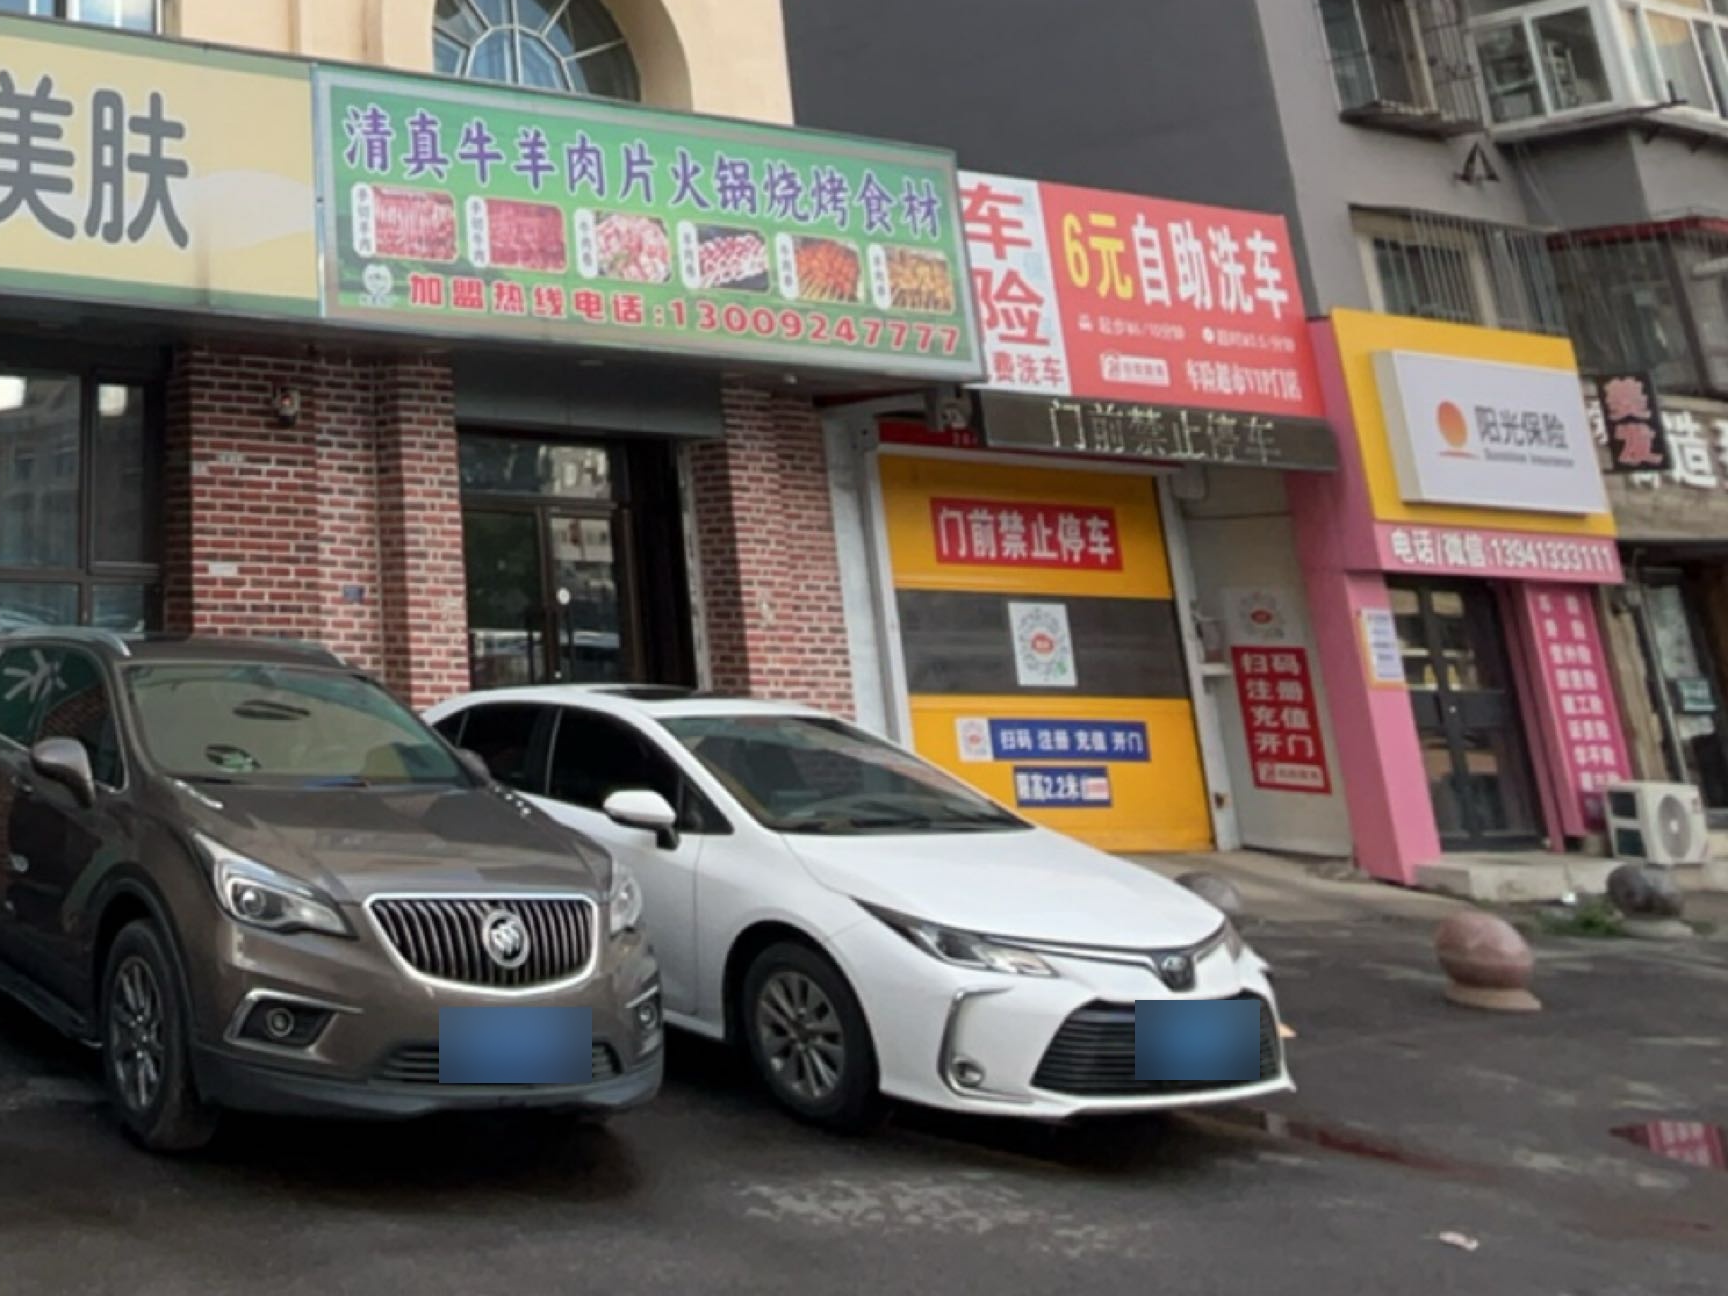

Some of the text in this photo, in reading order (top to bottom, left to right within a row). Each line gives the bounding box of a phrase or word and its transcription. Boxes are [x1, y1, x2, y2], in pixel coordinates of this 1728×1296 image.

[342, 104, 942, 240] 清真牛羊肉片火锅烧烤食材
[1062, 211, 1290, 324] 6元自助洗车
[986, 351, 1065, 388] 费洗车
[1048, 398, 1282, 465] 门前禁止停车
[1474, 404, 1569, 449] 阳光保险
[936, 506, 1115, 565] 门前禁止停车
[1240, 652, 1301, 676] 扫码
[1251, 705, 1311, 730] 充值
[1253, 732, 1315, 759] 开门
